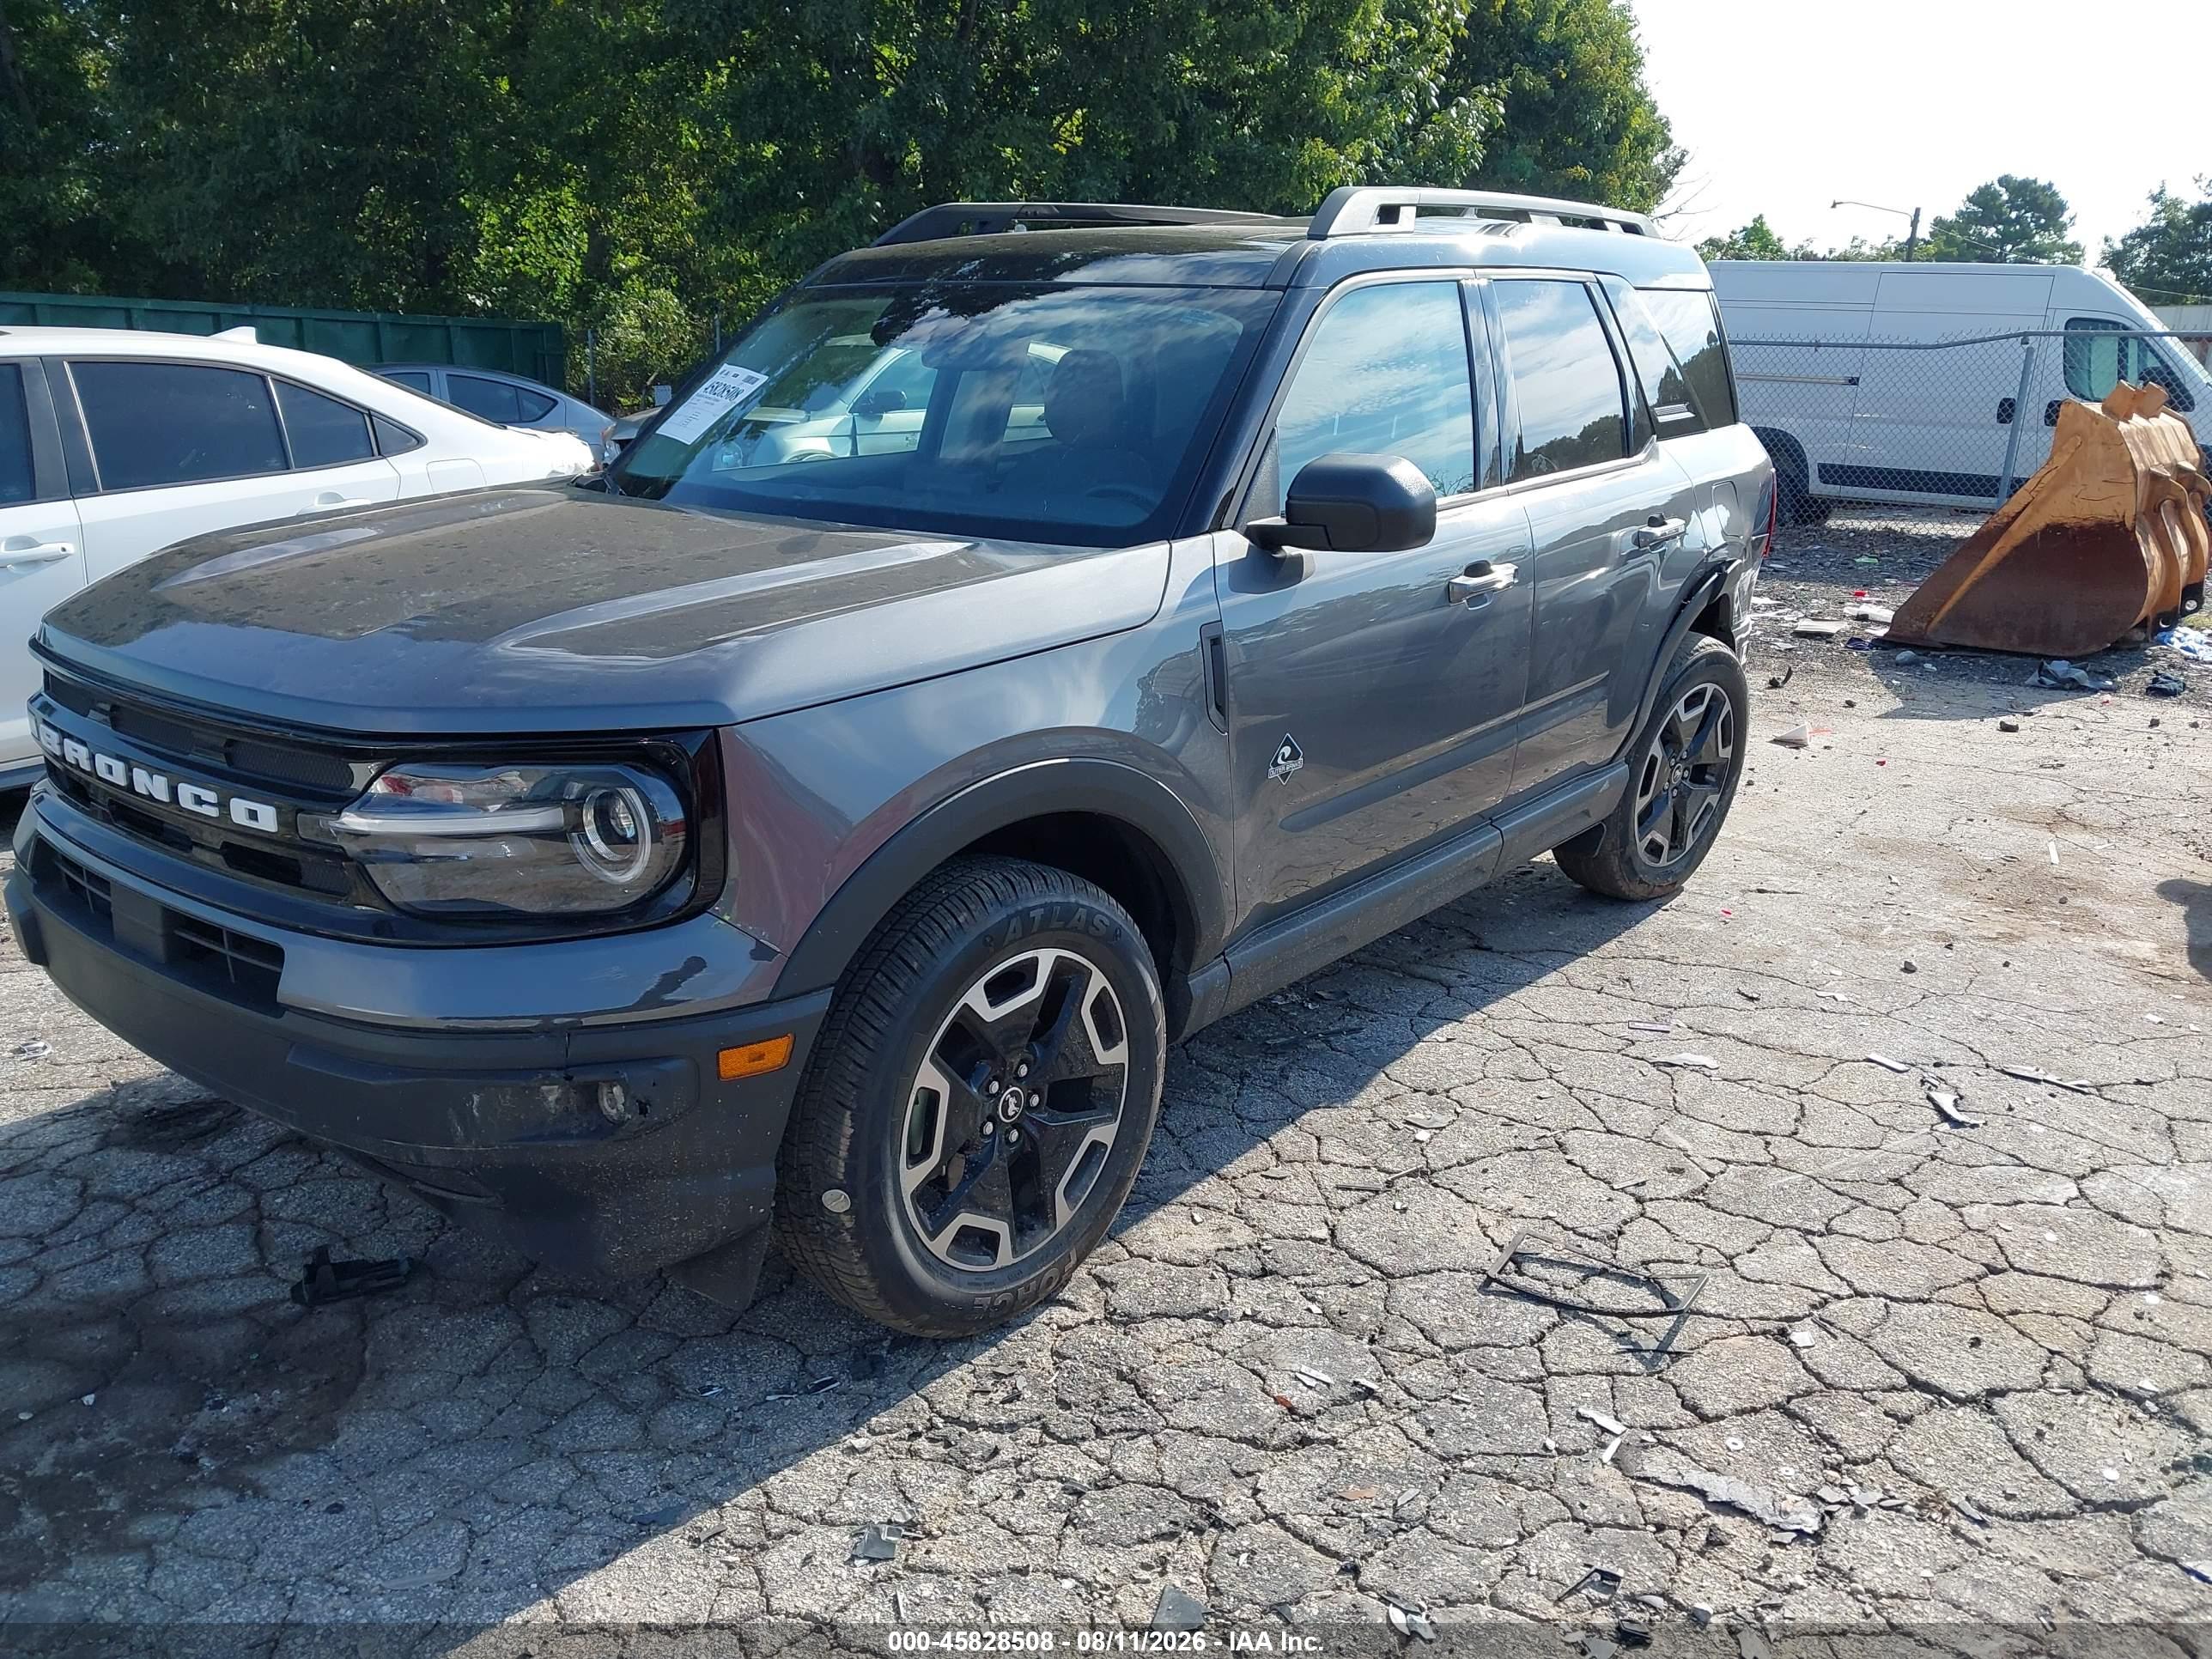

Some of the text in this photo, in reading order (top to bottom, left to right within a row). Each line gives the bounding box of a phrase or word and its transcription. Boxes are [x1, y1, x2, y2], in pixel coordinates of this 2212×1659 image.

[40, 723, 278, 833] BRONCO
[1270, 766, 1285, 776] OUTER
[1003, 906, 1110, 946] ATLAS
